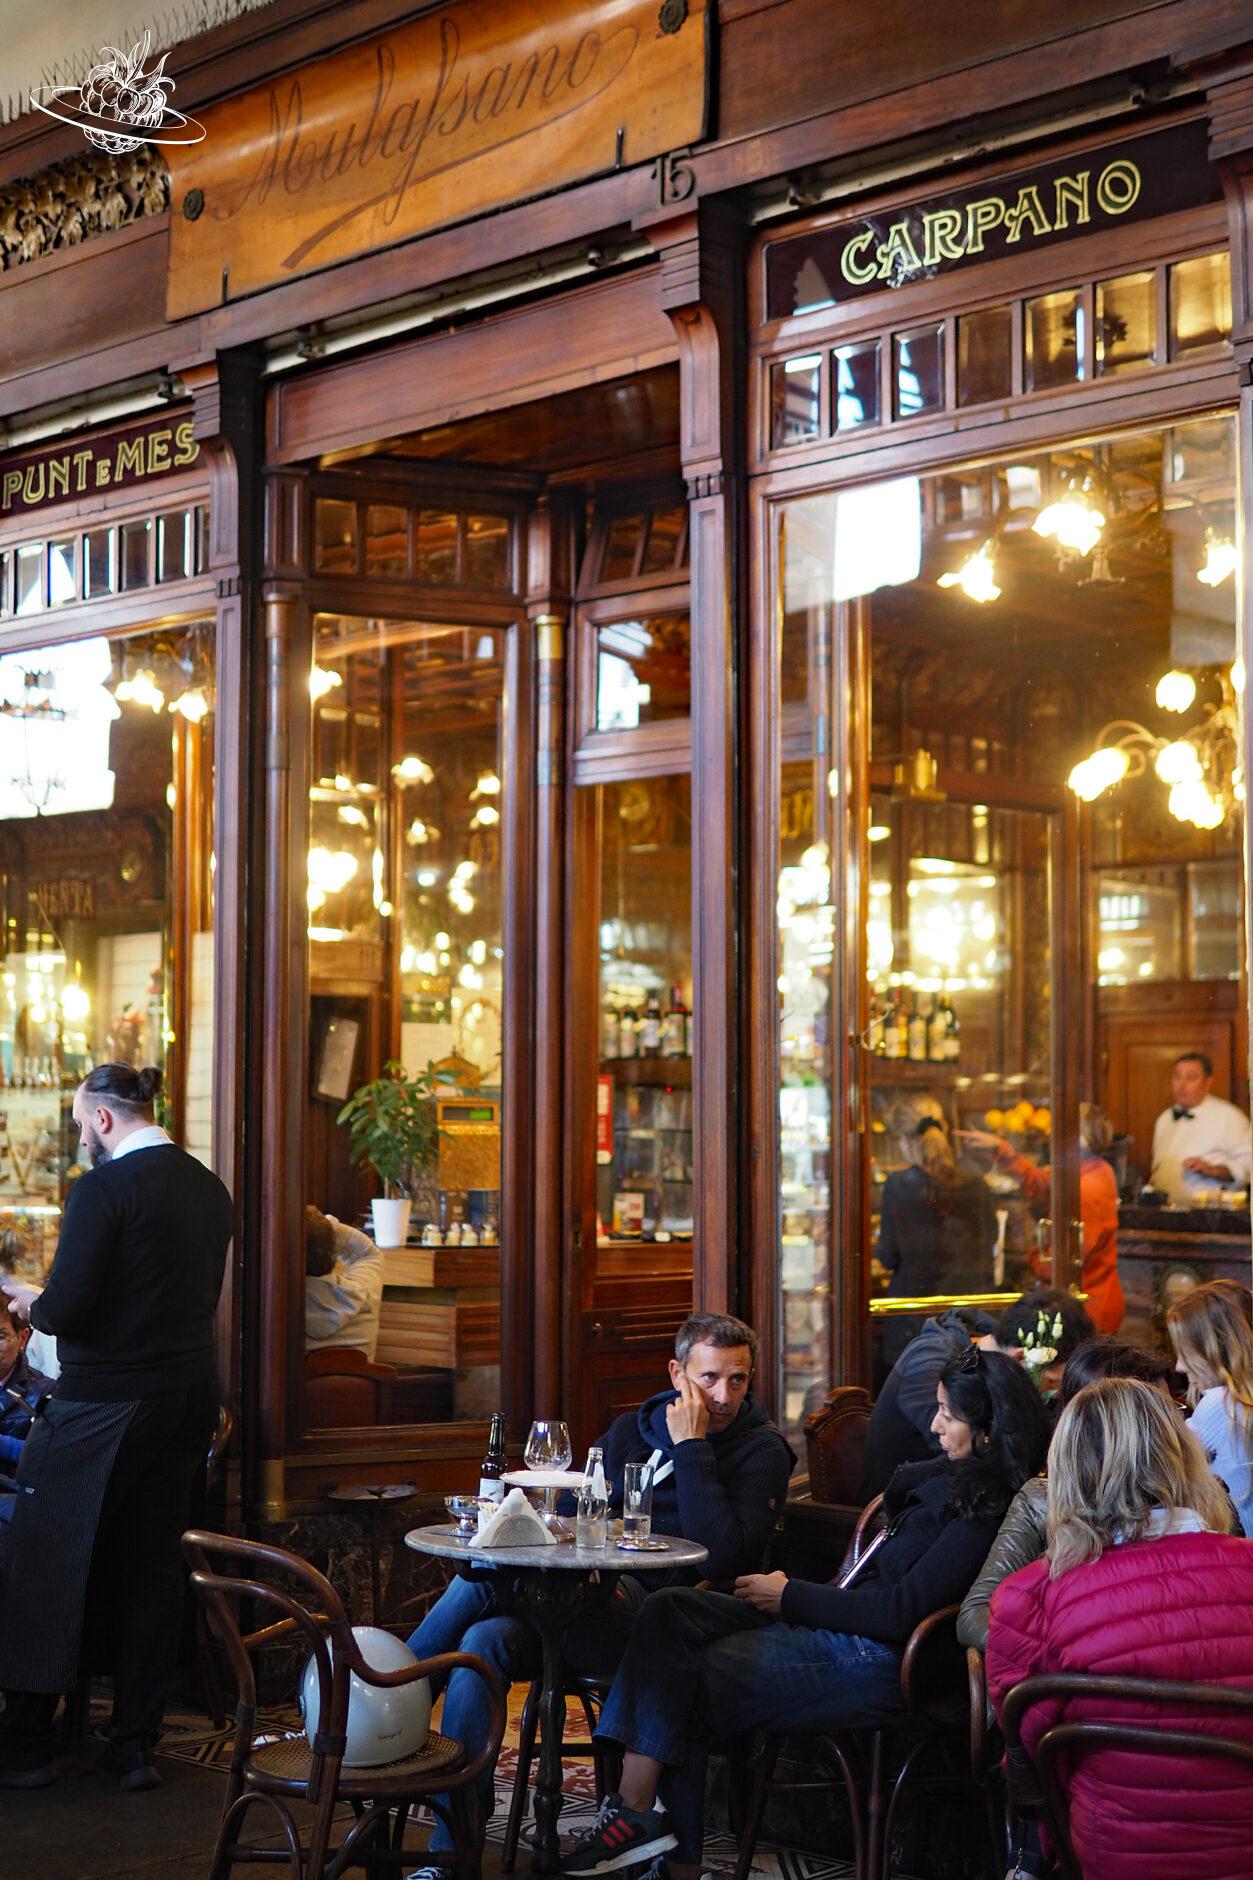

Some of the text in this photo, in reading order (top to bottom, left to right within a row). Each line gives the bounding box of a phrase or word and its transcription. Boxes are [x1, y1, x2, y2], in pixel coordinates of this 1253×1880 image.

[651, 148, 696, 209] 15
[840, 158, 1142, 286] CARPANO
[2, 450, 93, 510] PUNT
[114, 422, 201, 483] MES
